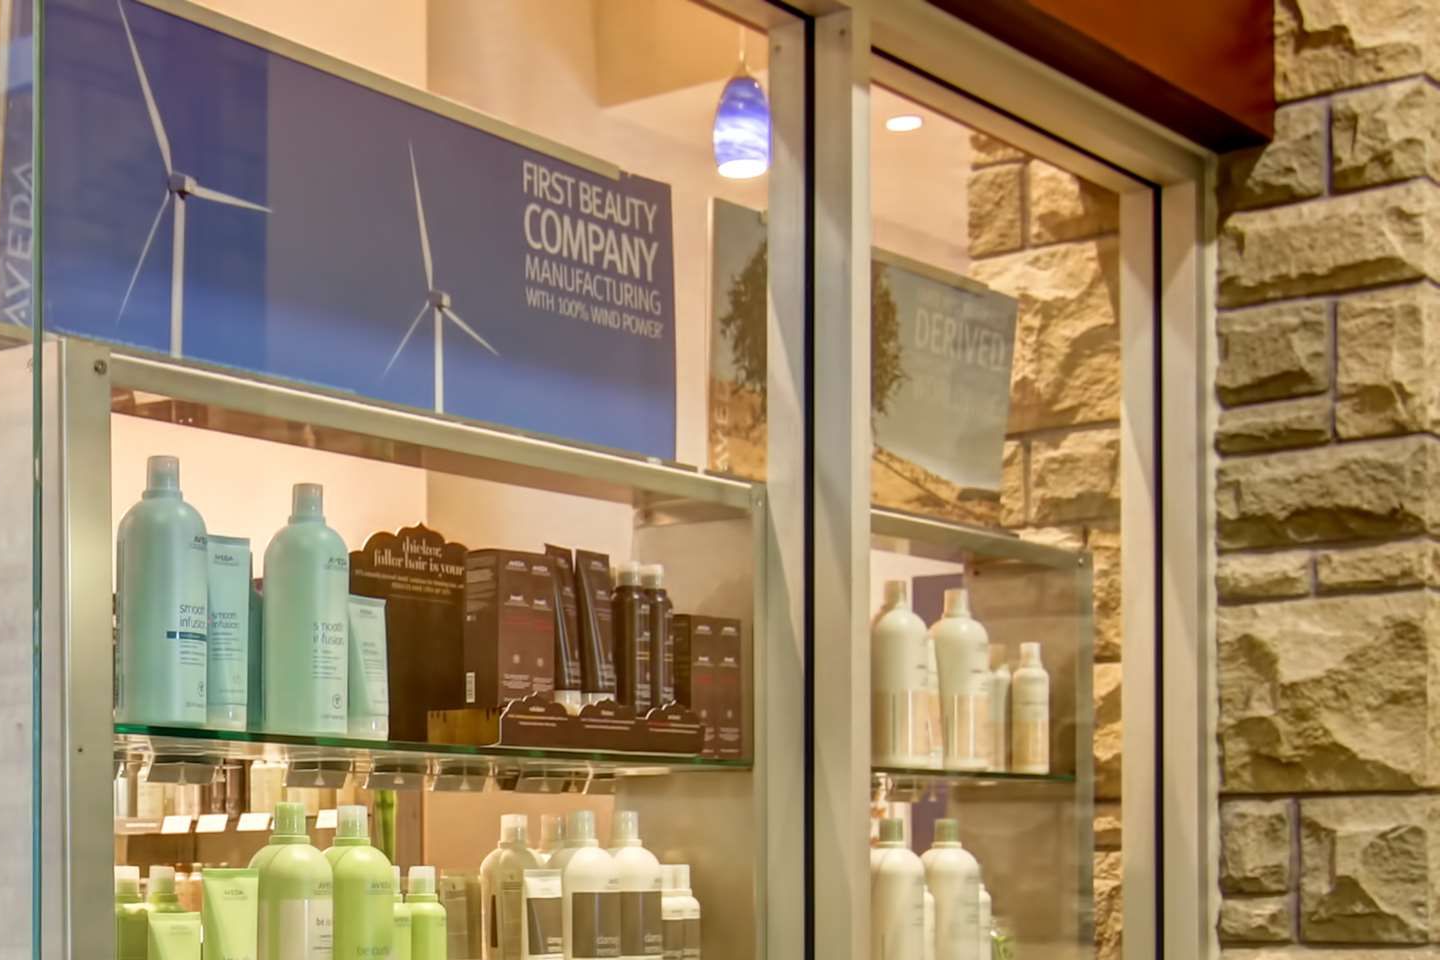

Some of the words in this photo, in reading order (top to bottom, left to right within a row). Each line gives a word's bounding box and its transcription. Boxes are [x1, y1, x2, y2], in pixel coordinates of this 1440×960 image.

[522, 160, 575, 208] FIRST
[578, 182, 658, 234] BEAUTY
[524, 203, 659, 282] COMPANY
[525, 254, 662, 315] MANUFACTURING
[525, 286, 555, 313] WITH
[558, 297, 590, 322] 100%
[590, 306, 621, 329] WIND
[373, 548, 403, 567] fuller
[404, 552, 428, 570] hair
[429, 557, 439, 572] is
